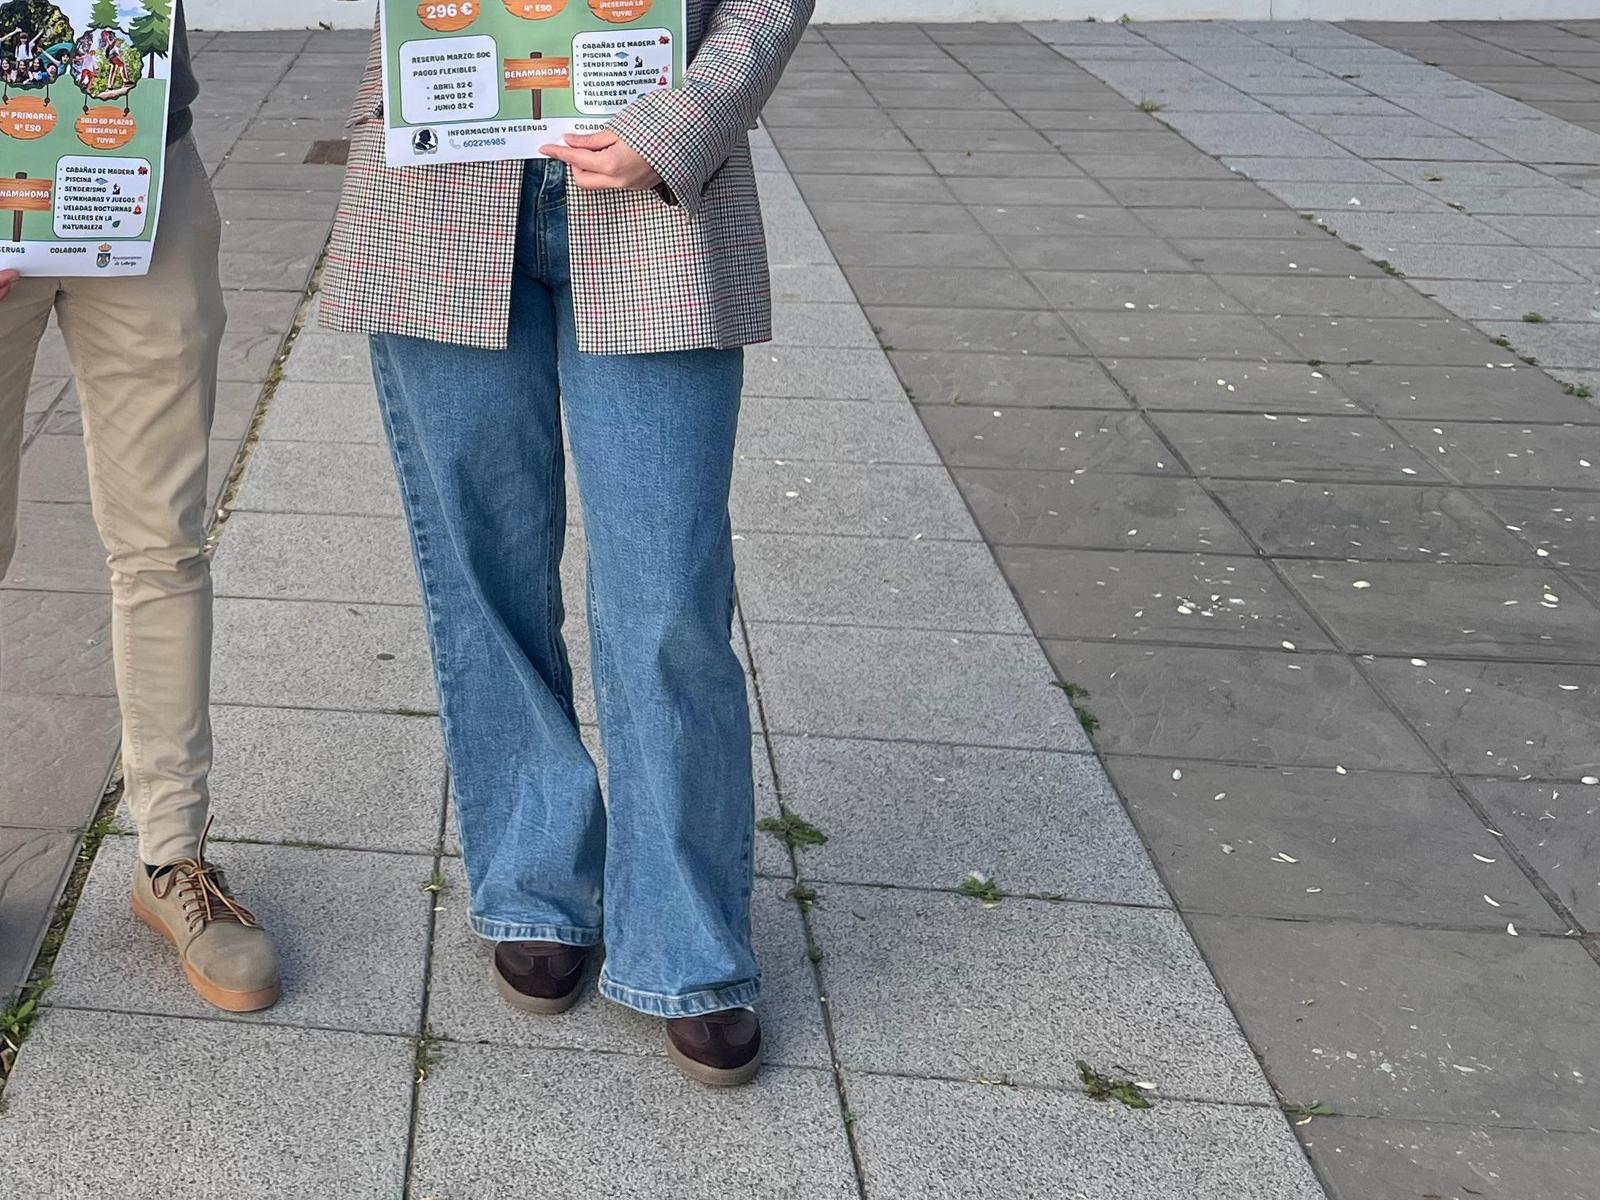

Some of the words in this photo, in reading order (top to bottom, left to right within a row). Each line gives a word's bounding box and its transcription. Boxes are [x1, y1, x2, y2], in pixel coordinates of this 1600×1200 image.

[426, 3, 457, 19] 296
[460, 2, 473, 16] €
[535, 4, 552, 12] ESO
[582, 41, 615, 49] CABAÑAS
[505, 68, 567, 78] BENAMAHOMA
[616, 78, 657, 86] NOCTURNAS
[24, 124, 41, 132] ESO
[448, 127, 499, 137] INFORMACIÓN
[508, 124, 547, 133] RESERVAS
[463, 138, 506, 148] 602216985
